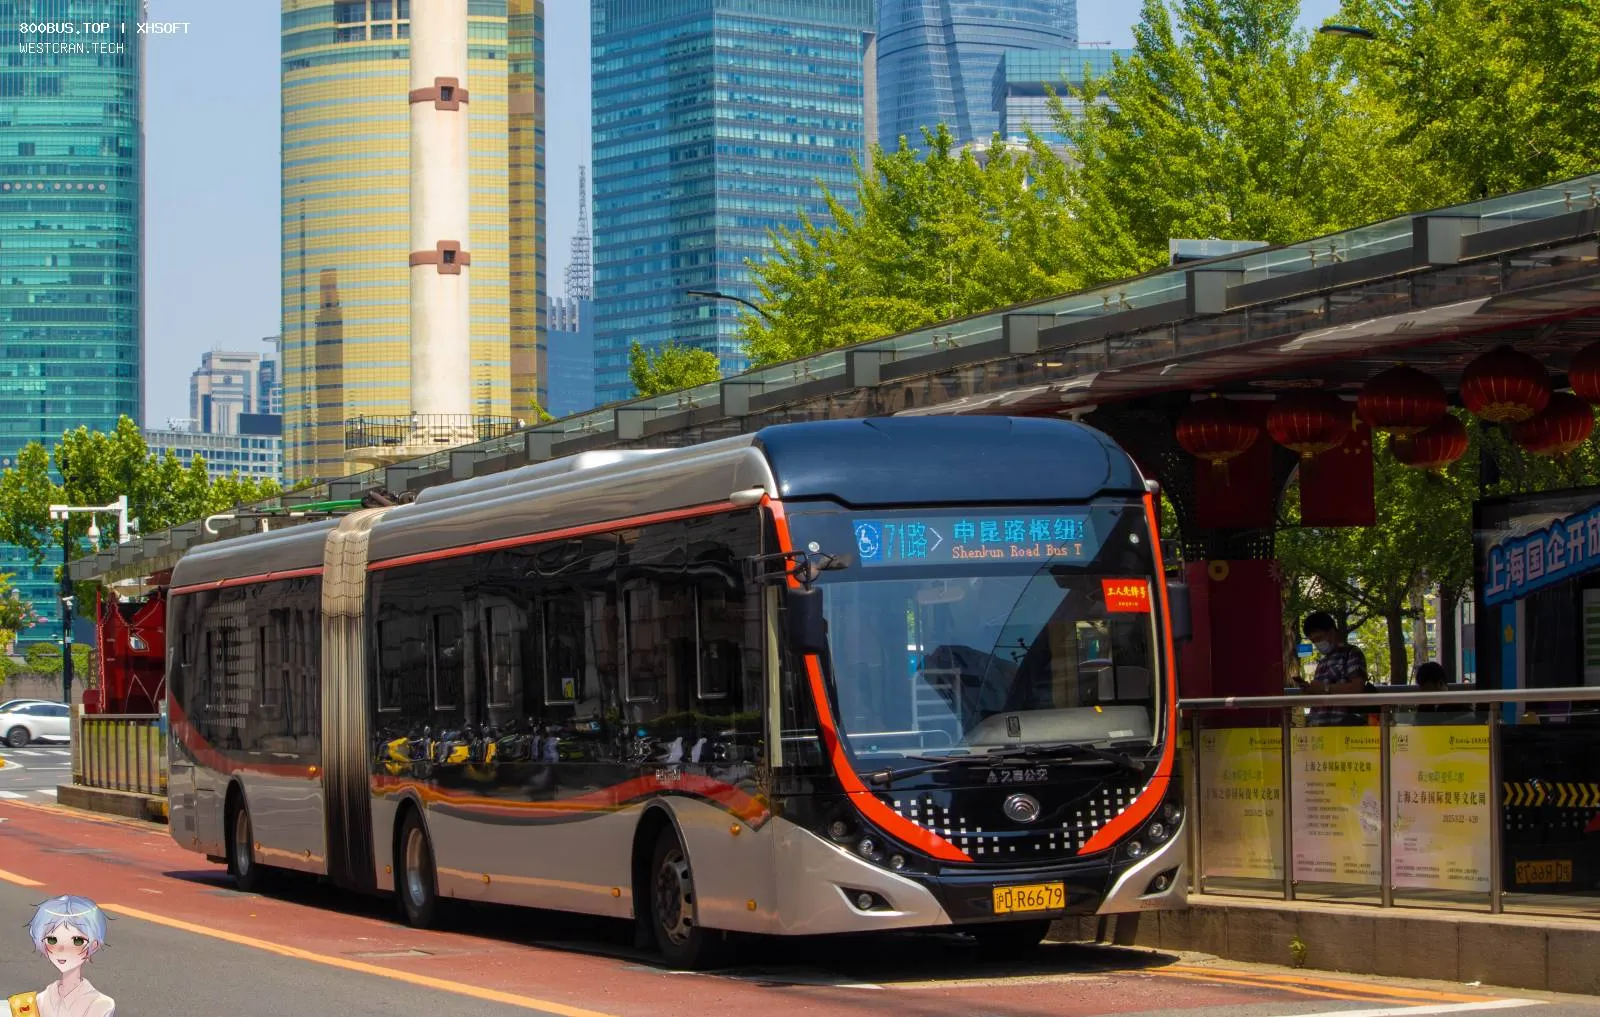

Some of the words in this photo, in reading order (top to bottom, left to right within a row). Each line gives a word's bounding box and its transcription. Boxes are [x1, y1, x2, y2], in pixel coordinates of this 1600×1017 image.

[953, 518, 1084, 544] 申昆路枢纽
[952, 545, 1004, 559] Shenkun
[1011, 543, 1040, 557] Road
[1046, 543, 1068, 556] Bus
